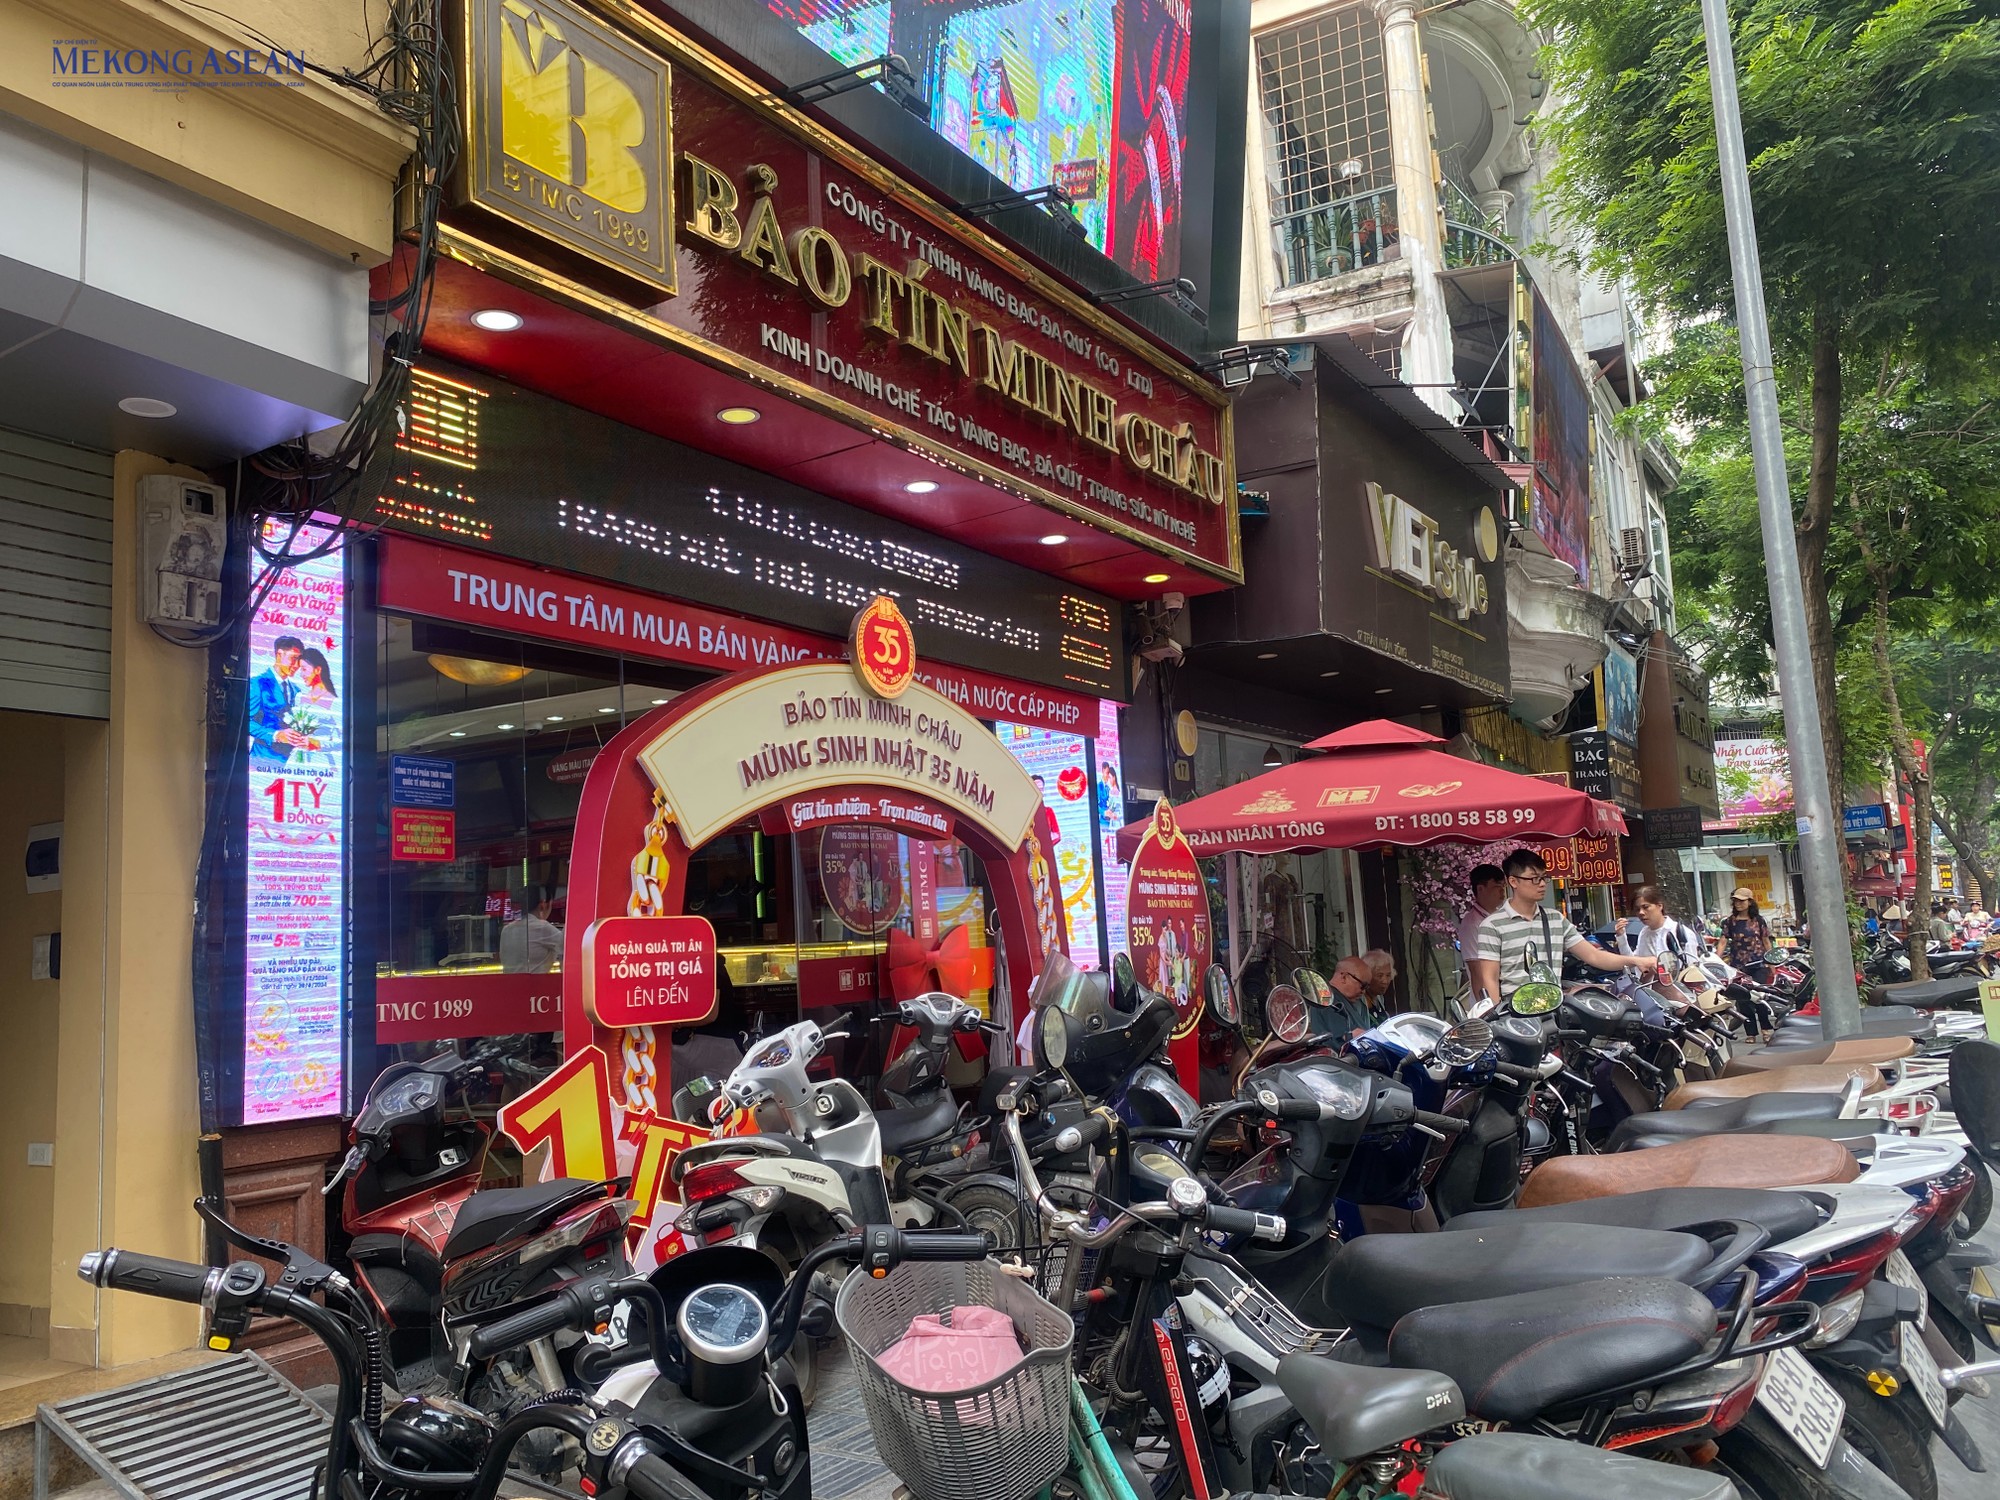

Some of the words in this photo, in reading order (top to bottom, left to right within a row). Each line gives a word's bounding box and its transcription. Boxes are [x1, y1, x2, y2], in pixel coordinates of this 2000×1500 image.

[502, 160, 584, 221] BTMC
[592, 207, 650, 253] 1989
[826, 181, 887, 234] CÔNG
[888, 216, 911, 250] TY
[916, 235, 963, 282] TNHH
[965, 265, 1006, 308] VÀNG
[1007, 297, 1039, 327] BẠC
[682, 151, 852, 312] BẢO
[855, 252, 970, 377] TÍN
[976, 322, 1119, 455] MINH
[1116, 412, 1225, 506] CHÂU
[761, 322, 811, 367] KINH
[815, 348, 883, 401] DOANH
[884, 379, 922, 418] CHẾ
[926, 400, 957, 433] TÁC
[959, 415, 999, 454] VÀNG
[1035, 452, 1055, 479] ĐÁ
[1087, 478, 1128, 511] TRANG
[1129, 497, 1153, 522] SỨC
[1170, 516, 1197, 547] NGHỆ
[302, 577, 335, 595] Cưới
[299, 593, 336, 616] Vàng
[448, 569, 558, 622] TRUNG
[564, 595, 625, 636] TÂM
[632, 612, 692, 649] MUA
[698, 623, 748, 661] BÁN
[261, 609, 290, 626] sức
[294, 616, 329, 632] cưới
[873, 625, 902, 666] 35
[936, 678, 969, 704] NHÀ
[973, 687, 1016, 713] NƯỚC
[1018, 692, 1047, 718] CẤP
[1050, 699, 1080, 726] PHÉP
[782, 690, 828, 727] BẢO
[830, 689, 863, 719] TÍN
[867, 698, 912, 728] MINH
[917, 711, 962, 751] CHÂU
[1574, 749, 1605, 765] BẠC
[1744, 744, 1769, 756] Cưới
[256, 765, 272, 773] QUÀ
[273, 766, 292, 775] TẶNG
[293, 768, 305, 776] LÊN
[306, 768, 317, 777] TỚI
[739, 736, 811, 789] MỪNG
[816, 735, 869, 768] SINH
[872, 736, 927, 777] NHẬT
[930, 753, 953, 785] 35
[955, 765, 996, 812] NĂM
[1176, 762, 1188, 779] 17
[1575, 769, 1609, 779] TRANG
[264, 778, 285, 823] 1
[287, 777, 328, 809] TỶ
[287, 808, 324, 825] ĐỒNG
[791, 801, 815, 828] Giữ
[815, 798, 834, 819] tín
[834, 797, 871, 821] nhiệm
[878, 798, 906, 824] Trọn
[905, 804, 932, 826] niềm
[931, 812, 947, 833] tin
[1160, 811, 1171, 832] 35
[1852, 808, 1868, 816] PHỐ
[1852, 816, 1864, 829] VIỆT
[1864, 815, 1882, 827] VƯƠNG
[1226, 824, 1275, 844] NHÂN
[1276, 820, 1326, 838] TÔNG
[1375, 816, 1404, 831] ĐT:
[1410, 812, 1454, 828] 1800
[1458, 810, 1482, 826] 58
[1485, 809, 1509, 825] 58
[1512, 807, 1536, 823] 99
[1575, 837, 1608, 858] BẠC
[825, 860, 847, 873] 35%
[255, 874, 277, 882] VÒNG
[264, 883, 282, 891] 100%
[283, 883, 306, 891] TRÚNG
[920, 860, 931, 912] BTMC
[1154, 883, 1167, 895] SINH
[1180, 884, 1187, 895] 35
[293, 895, 317, 907] 700
[273, 934, 284, 947] 5
[609, 940, 643, 956] NGÀN
[645, 939, 669, 954] QUÀ
[670, 941, 685, 953] TRI
[687, 938, 702, 952] ÂN
[1132, 926, 1155, 946] 35%
[609, 956, 651, 979] TỔNG
[654, 960, 675, 980] TRỊ
[678, 956, 703, 976] GIÁ
[626, 985, 654, 1007] LÊN
[658, 981, 689, 1005] ĐẾN
[431, 997, 474, 1020] 1989
[1160, 1346, 1186, 1423] espero
[1426, 1391, 1452, 1411] DPK
[1793, 1375, 1841, 1461] 798.93
